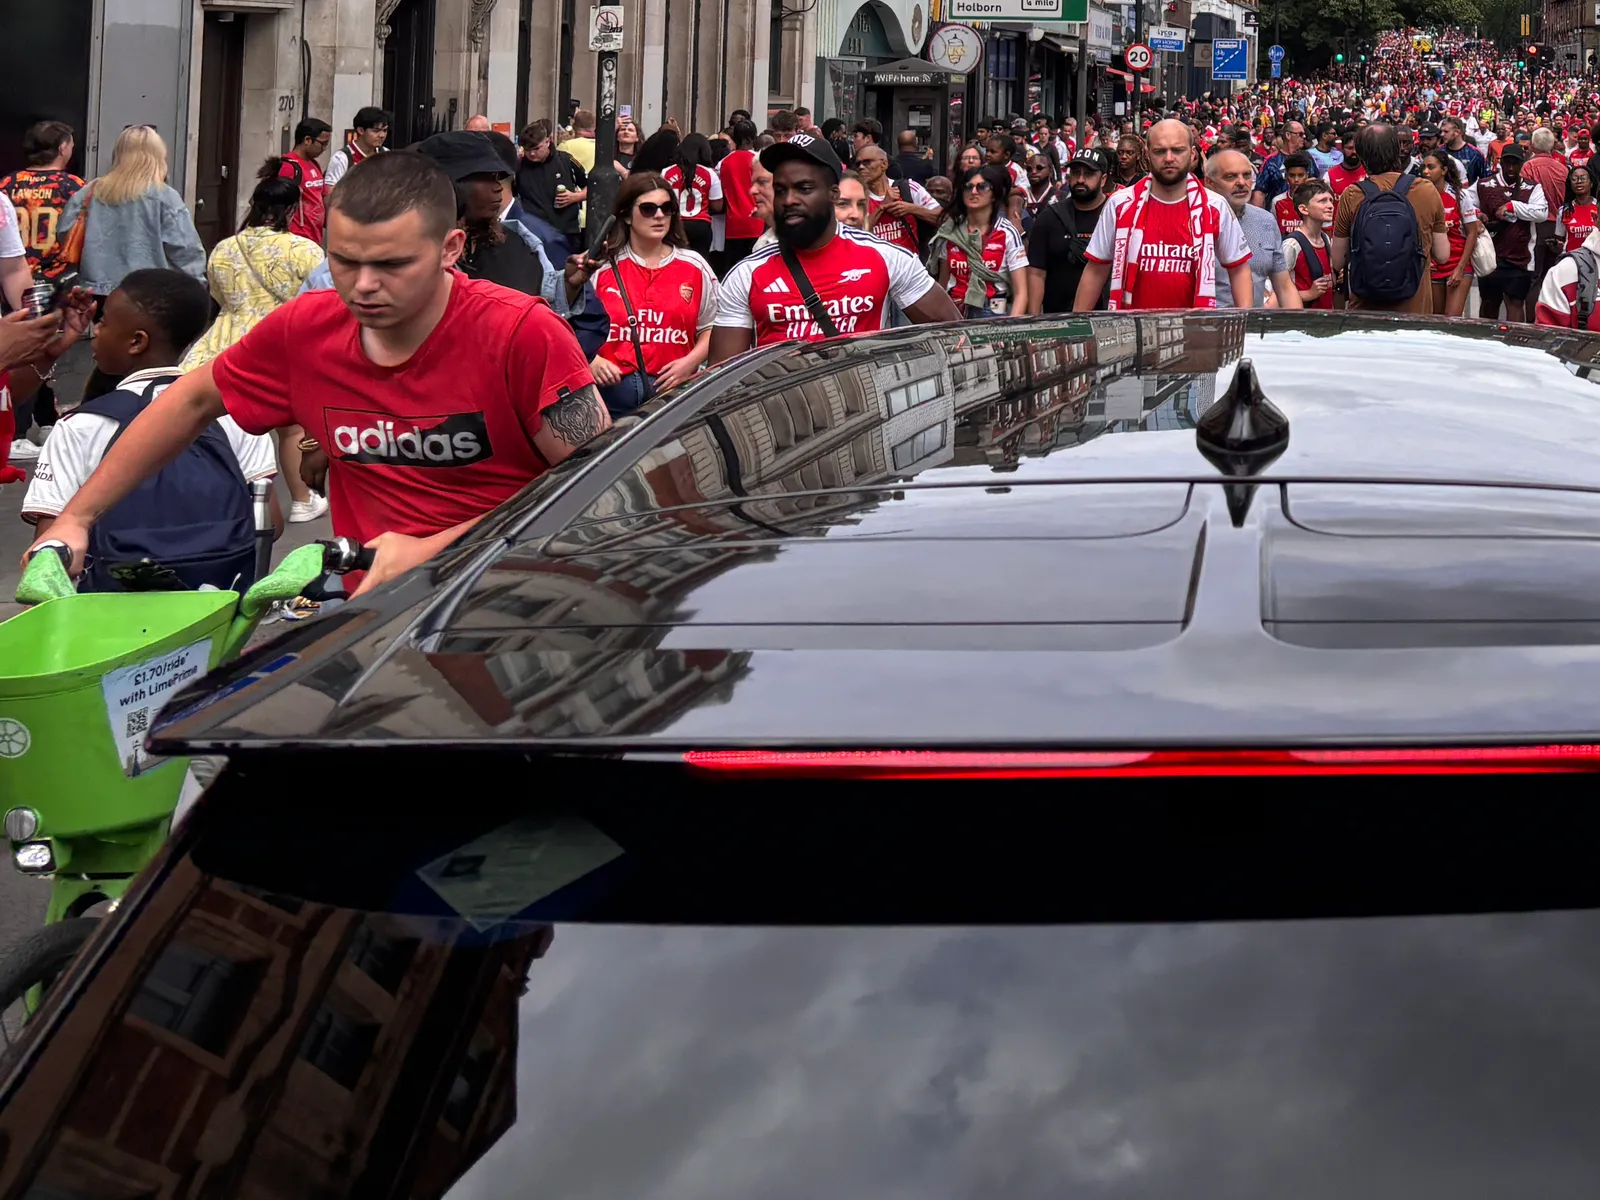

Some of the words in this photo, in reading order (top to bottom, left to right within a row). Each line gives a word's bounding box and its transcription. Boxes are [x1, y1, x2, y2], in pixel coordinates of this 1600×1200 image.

[957, 2, 1002, 12] Holborn
[1129, 51, 1149, 63] 20
[900, 73, 920, 83] here
[279, 95, 295, 111] 270
[1072, 148, 1100, 161] ICON
[11, 188, 53, 200] LAWSON
[1140, 240, 1199, 259] mirate
[1139, 259, 1155, 272] FLY
[1158, 259, 1192, 273] BETTER
[637, 308, 664, 326] Fly
[786, 320, 808, 339] FLY
[334, 420, 482, 462] adidas
[119, 687, 146, 707] with
[148, 665, 198, 696] LimePrime
